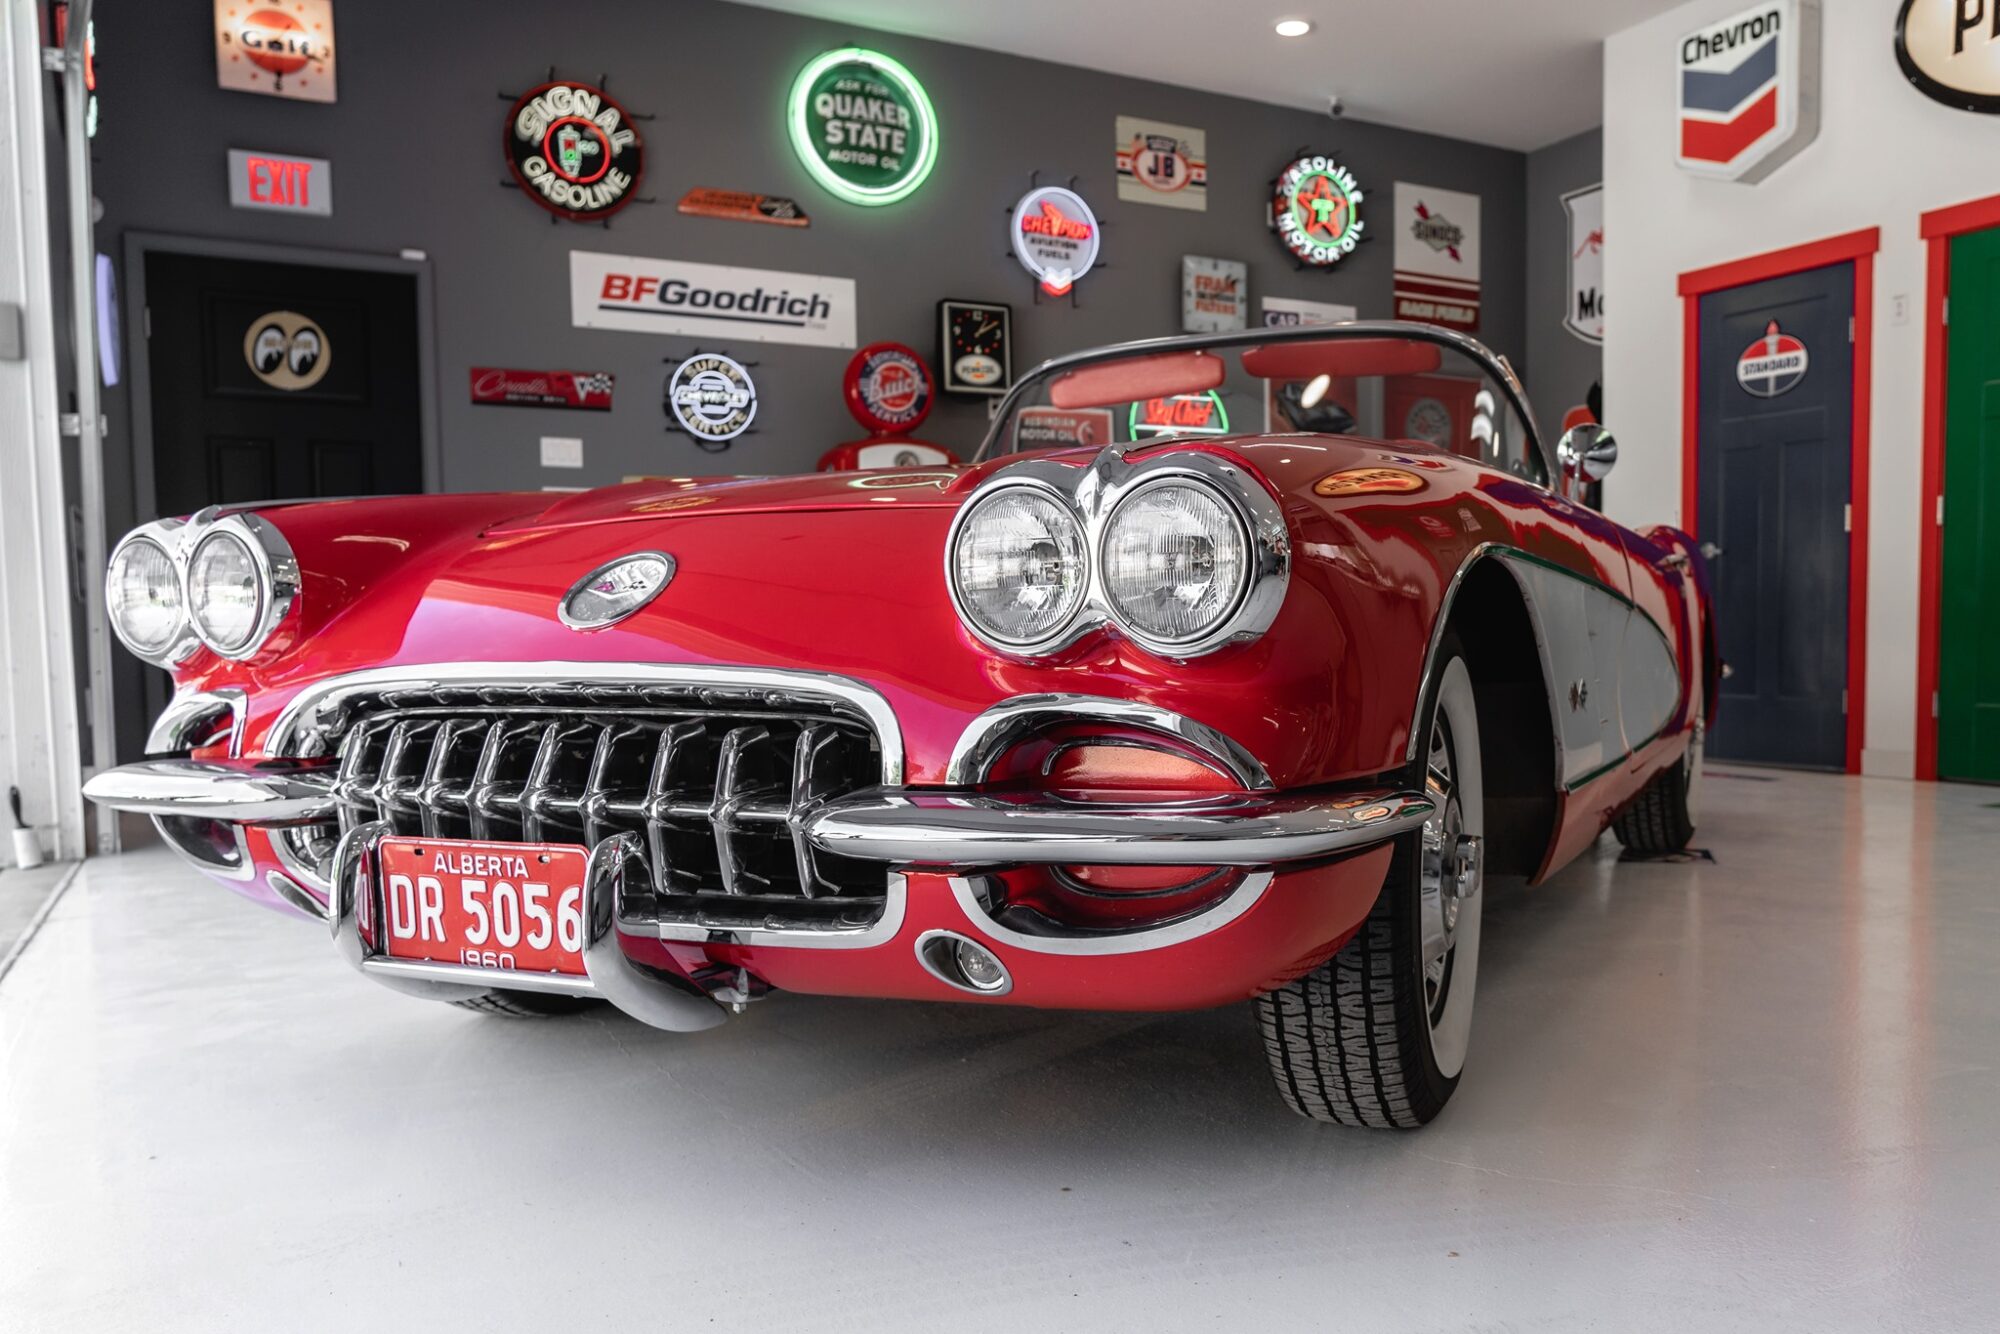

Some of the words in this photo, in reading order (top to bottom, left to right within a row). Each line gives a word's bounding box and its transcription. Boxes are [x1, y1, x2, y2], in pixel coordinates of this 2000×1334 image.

[1682, 10, 1780, 65] Chevron
[1953, 0, 2000, 55] P
[835, 79, 861, 92] ASK
[515, 86, 635, 157] SIGNAL
[814, 92, 911, 130] QUAKER
[825, 119, 907, 155] STATE
[827, 148, 878, 167] MOTOR
[247, 155, 313, 208] EXIT
[523, 155, 632, 209] GASOLINE
[1279, 212, 1340, 263] MOTOR
[1341, 220, 1365, 253] OIL
[601, 272, 831, 321] BFGoodrich
[1578, 287, 1604, 322] M
[684, 359, 743, 382] SUPER
[1743, 355, 1801, 376] STANDARD
[433, 852, 529, 878] ALBERTA
[389, 874, 447, 943] DR
[461, 877, 583, 953] 5056
